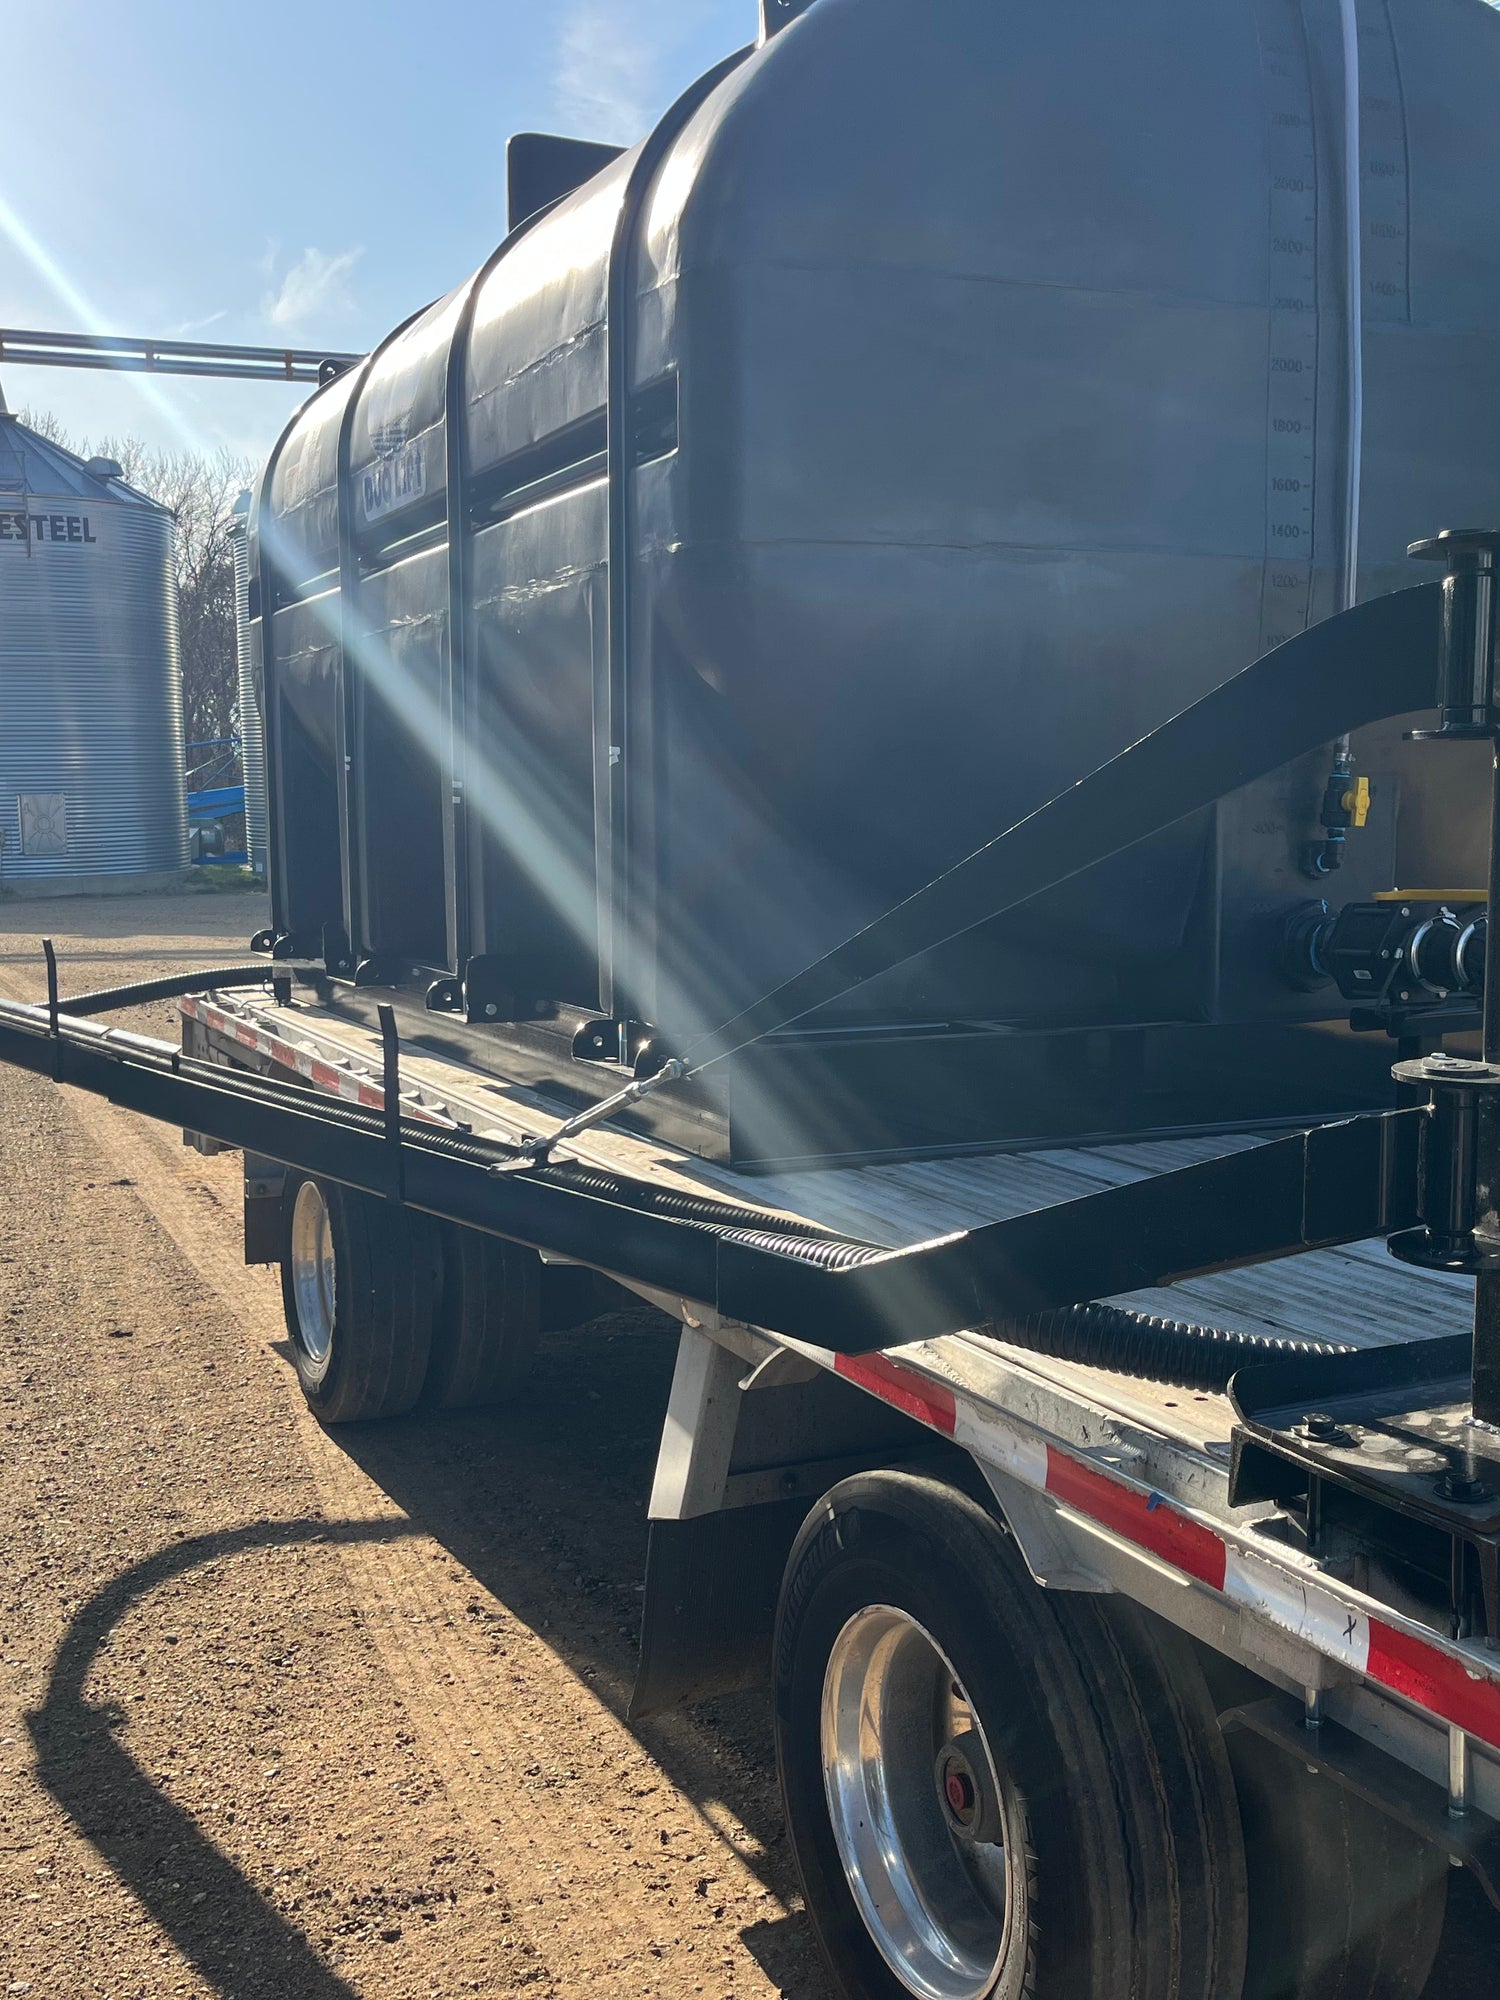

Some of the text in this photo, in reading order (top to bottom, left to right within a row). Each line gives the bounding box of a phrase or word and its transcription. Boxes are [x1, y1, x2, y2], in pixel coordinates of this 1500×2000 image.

[1271, 358, 1302, 373] 2000
[1272, 419, 1300, 433] 1800
[364, 466, 391, 513] DUO
[1272, 477, 1299, 492] 1600
[1271, 523, 1299, 538] 1400
[1271, 573, 1298, 588] 1200
